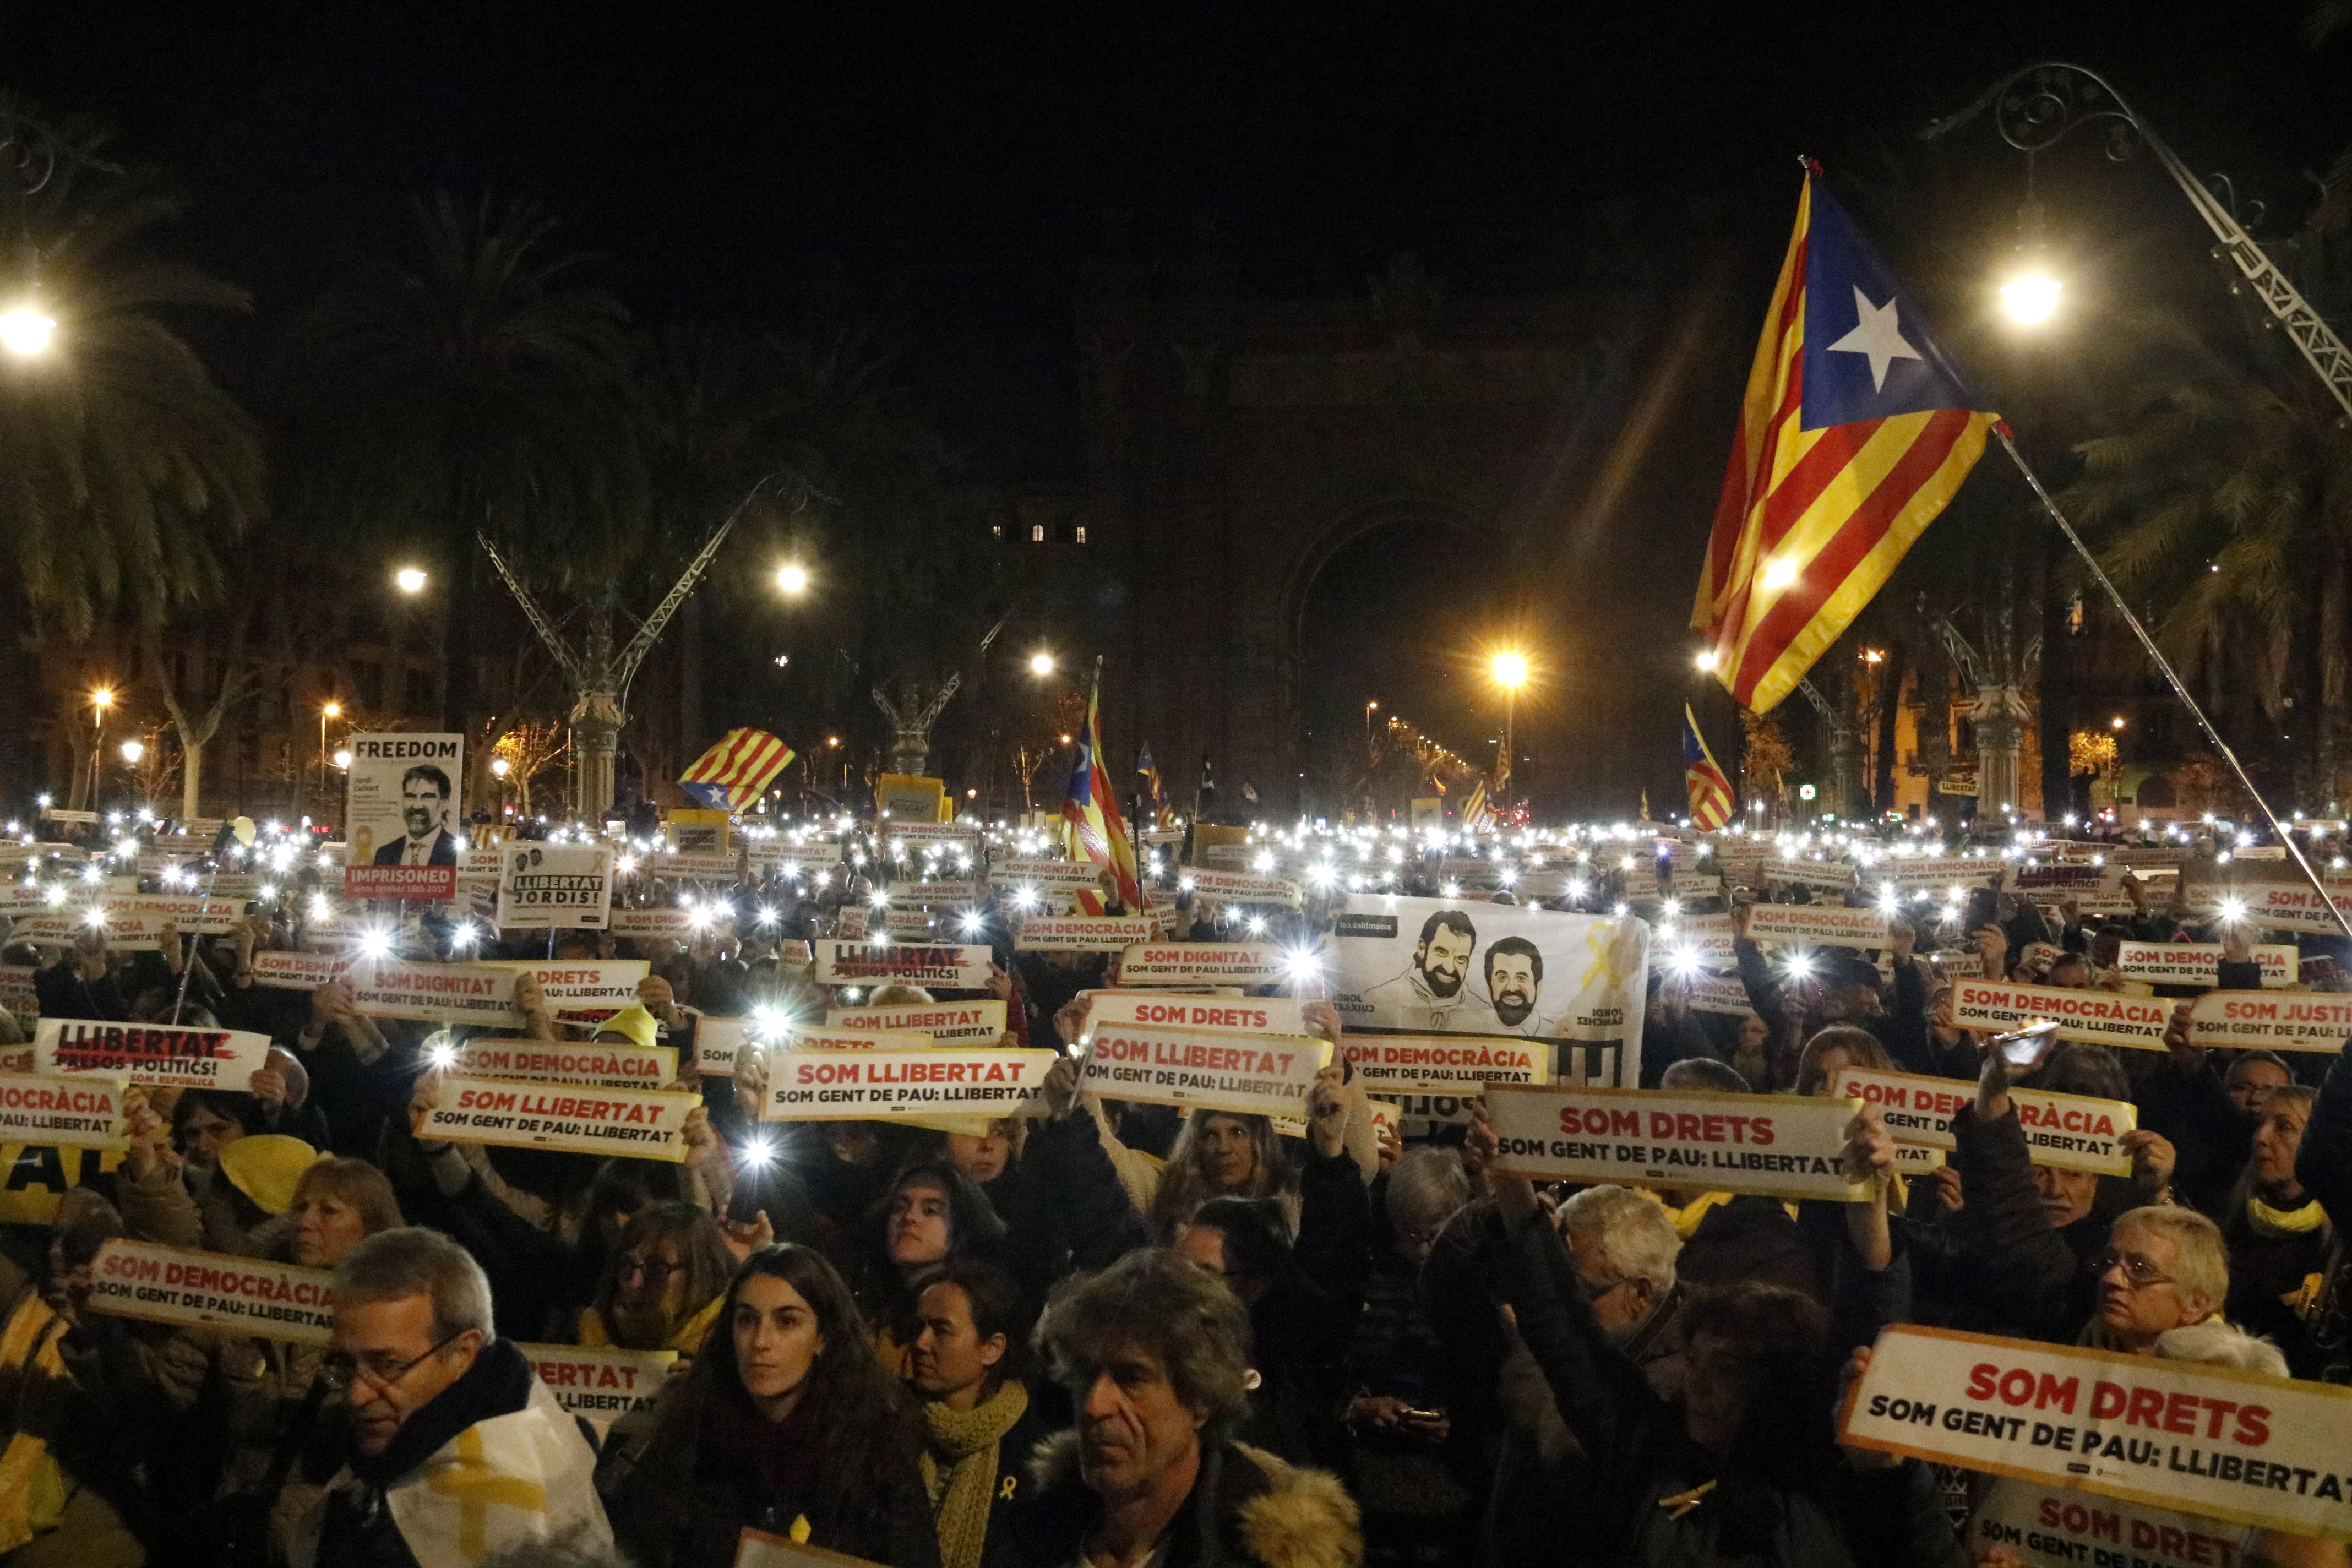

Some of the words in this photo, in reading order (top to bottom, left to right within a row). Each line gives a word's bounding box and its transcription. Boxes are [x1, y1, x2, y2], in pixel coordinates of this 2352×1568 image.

[356, 741, 457, 758] FREEDOM
[1942, 783, 1976, 791] LLIBERTAT
[470, 856, 498, 864] SOM
[351, 869, 450, 883] IMPRISONED
[516, 875, 602, 890] LLIBERTAT
[514, 891, 598, 904] JORDIS!
[2266, 891, 2307, 907] SOM
[1755, 911, 1785, 923] SOM
[1788, 912, 1885, 929] DEMOCRÀCIA
[2272, 909, 2304, 919] GENT
[1023, 924, 1053, 934] SOM
[1055, 921, 1146, 935] DEMOCRÀCIA
[1774, 925, 1797, 933] GENT
[1812, 928, 1833, 937] PAU:
[259, 958, 292, 970] SOM
[835, 943, 961, 967] LLIBERTAT
[1144, 950, 1179, 963] SOM
[1183, 951, 1261, 964] DIGNITAT
[2124, 950, 2159, 963] SOM
[536, 970, 602, 985] DRETS
[1126, 965, 1148, 973] SOM
[1151, 965, 1178, 973] GENT
[1195, 966, 1219, 974] PAU:
[2122, 964, 2146, 973] SOM
[2147, 965, 2176, 975] GENT
[2179, 966, 2195, 975] DE
[374, 971, 412, 989] SOM
[414, 974, 496, 995] DIGNITAT
[565, 988, 633, 997] LLIBERTAT
[384, 993, 409, 1004] GENT
[410, 995, 425, 1005] DE
[427, 997, 452, 1008] PAU:
[454, 998, 514, 1012] LLIBERTAT
[1962, 989, 2010, 1008] SOM
[2015, 993, 2164, 1024] DEMOCRÀCIA
[2225, 1000, 2278, 1020] SOM
[841, 1015, 881, 1030] SOM
[885, 1010, 983, 1029] LLIBERTAT
[1135, 1004, 1186, 1024] SOM
[1192, 1008, 1268, 1028] DRETS
[1959, 1006, 1988, 1019] SOM
[2086, 1019, 2163, 1037] LLIBERTAT
[933, 1026, 994, 1039] LLIBERTAT
[2196, 1021, 2228, 1034] SOM
[2231, 1023, 2272, 1035] GENT
[2274, 1025, 2294, 1036] DE
[2297, 1027, 2334, 1038] PAU:
[58, 1023, 221, 1058] LLIBERTAT
[464, 1050, 510, 1070] SOM
[515, 1052, 660, 1077] DEMOCRÀCIA
[702, 1049, 734, 1062] SOM
[1096, 1037, 1149, 1063] SOM
[1154, 1042, 1295, 1076] LLIBERTAT
[1384, 1046, 1532, 1069] DEMOCRÀCIA
[796, 1063, 861, 1085] SOM
[867, 1062, 1026, 1084] LLIBERTAT
[1113, 1066, 1153, 1084] GENT
[1156, 1071, 1176, 1086] DE
[1179, 1073, 1216, 1091] PAU:
[1218, 1076, 1307, 1099] LLIBERTAT
[1363, 1066, 1398, 1079] GENT
[1402, 1068, 1418, 1079] DE
[1422, 1069, 1453, 1080] PAU:
[1457, 1070, 1531, 1083] LLIBERTAT
[775, 1090, 814, 1103] SOM
[818, 1088, 866, 1103] GENT
[869, 1088, 894, 1102] DE
[897, 1088, 940, 1102] PAU:
[943, 1087, 1042, 1101] LLIBERTAT
[1844, 1081, 1907, 1108] SOM
[457, 1090, 516, 1113] SOM
[519, 1095, 665, 1124] LLIBERTAT
[31, 1115, 113, 1133] LLIBERTAT
[433, 1111, 469, 1126] SOM
[472, 1114, 515, 1128] GENT
[517, 1118, 540, 1132] DE
[542, 1120, 580, 1135] PAU:
[584, 1124, 674, 1143] LLIBERTAT
[1559, 1107, 1641, 1139] SOM
[1650, 1112, 1776, 1146] DRETS
[1883, 1112, 1932, 1131] GENT
[1498, 1137, 1545, 1156] SOM
[1550, 1141, 1610, 1159] GENT
[1616, 1144, 1647, 1163] DE
[1652, 1147, 1708, 1167] PAU:
[1712, 1150, 1844, 1176] LLIBERTAT
[102, 1254, 161, 1282] SOM
[97, 1281, 133, 1298] SOM
[135, 1286, 179, 1305] GENT
[182, 1293, 205, 1309] DE
[206, 1297, 246, 1315] PAU:
[1966, 1363, 2080, 1415] SOM
[2089, 1380, 2273, 1447] DRETS
[1868, 1395, 1937, 1427] SOM
[1942, 1407, 2027, 1442] GENT
[2030, 1422, 2076, 1452] DE
[2081, 1430, 2162, 1468] PAU:
[2038, 1496, 2121, 1545] SOM
[1982, 1520, 2022, 1547] SOM
[2027, 1532, 2089, 1563] GENT
